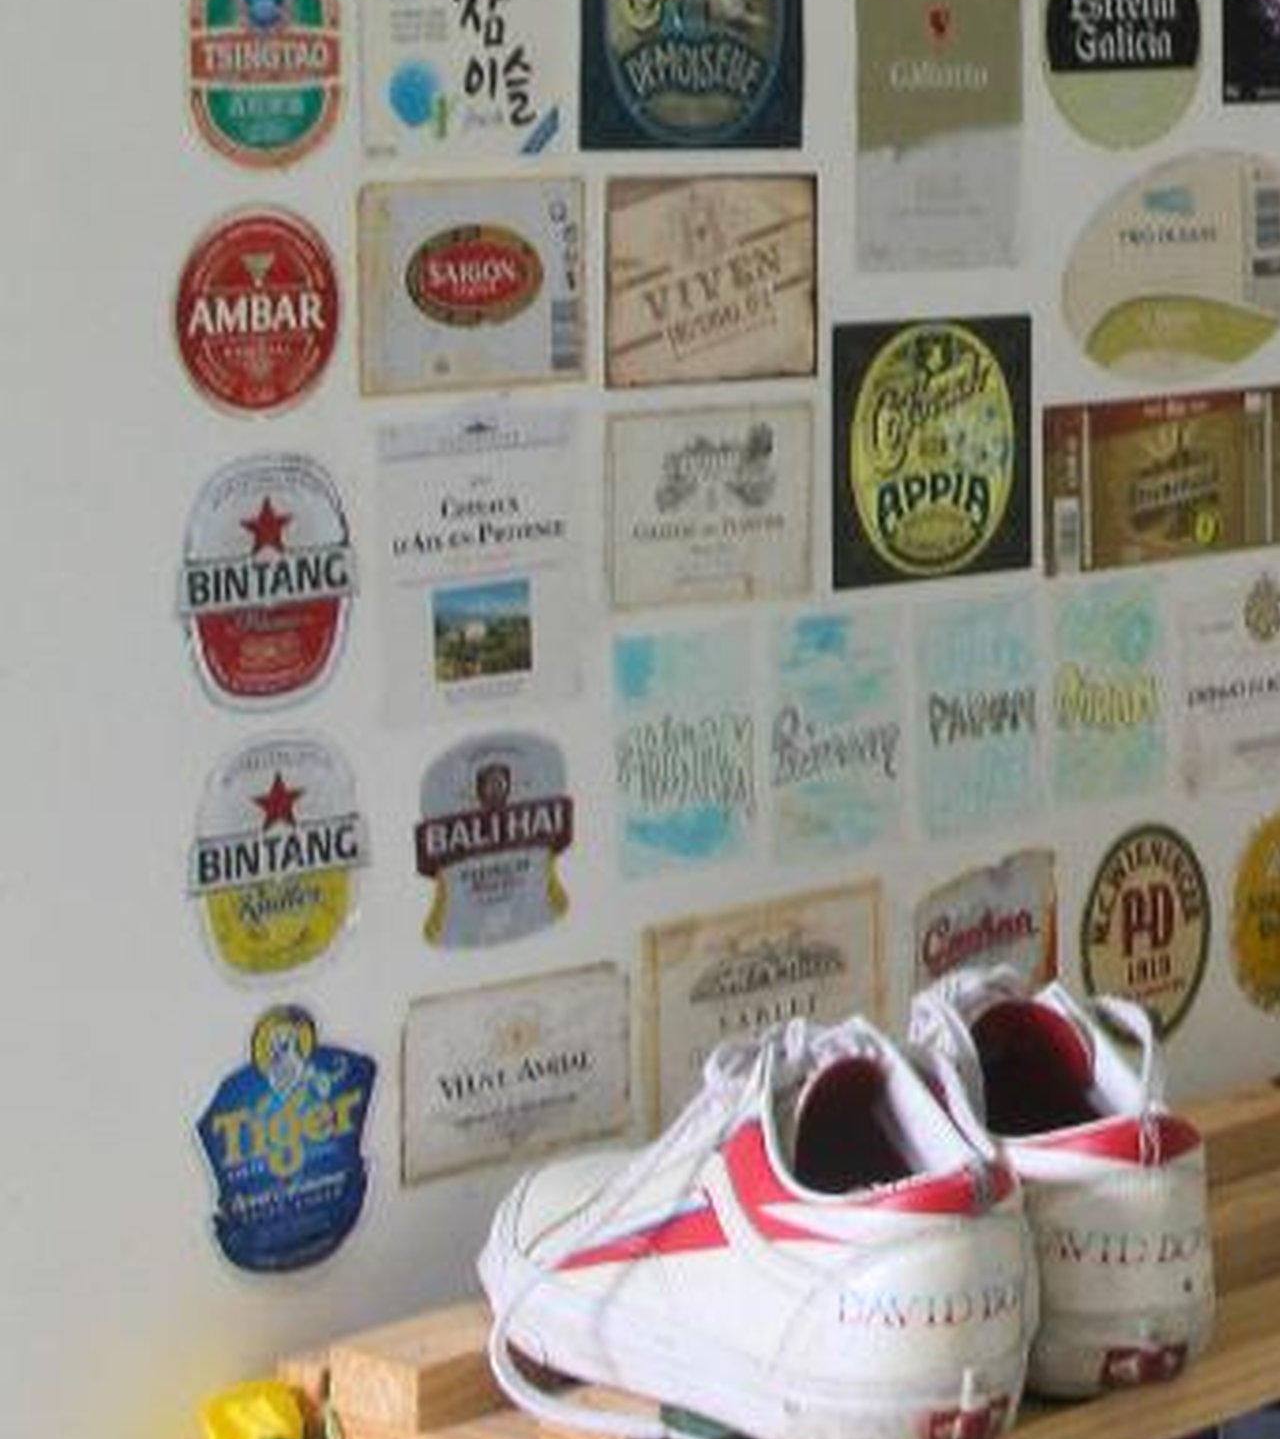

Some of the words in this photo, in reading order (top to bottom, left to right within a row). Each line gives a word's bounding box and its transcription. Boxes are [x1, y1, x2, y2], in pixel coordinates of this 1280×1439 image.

[199, 40, 331, 74] TSINGTAO
[1074, 26, 1175, 64] Galicia
[425, 255, 520, 287] SAIGON
[187, 294, 326, 335] AMBAR
[876, 467, 992, 534] APPIA
[186, 550, 349, 607] BINTANG
[198, 823, 359, 885] BINTANG
[425, 812, 501, 857] BALI
[507, 802, 563, 841] HAI
[210, 1088, 362, 1176] Tiger
